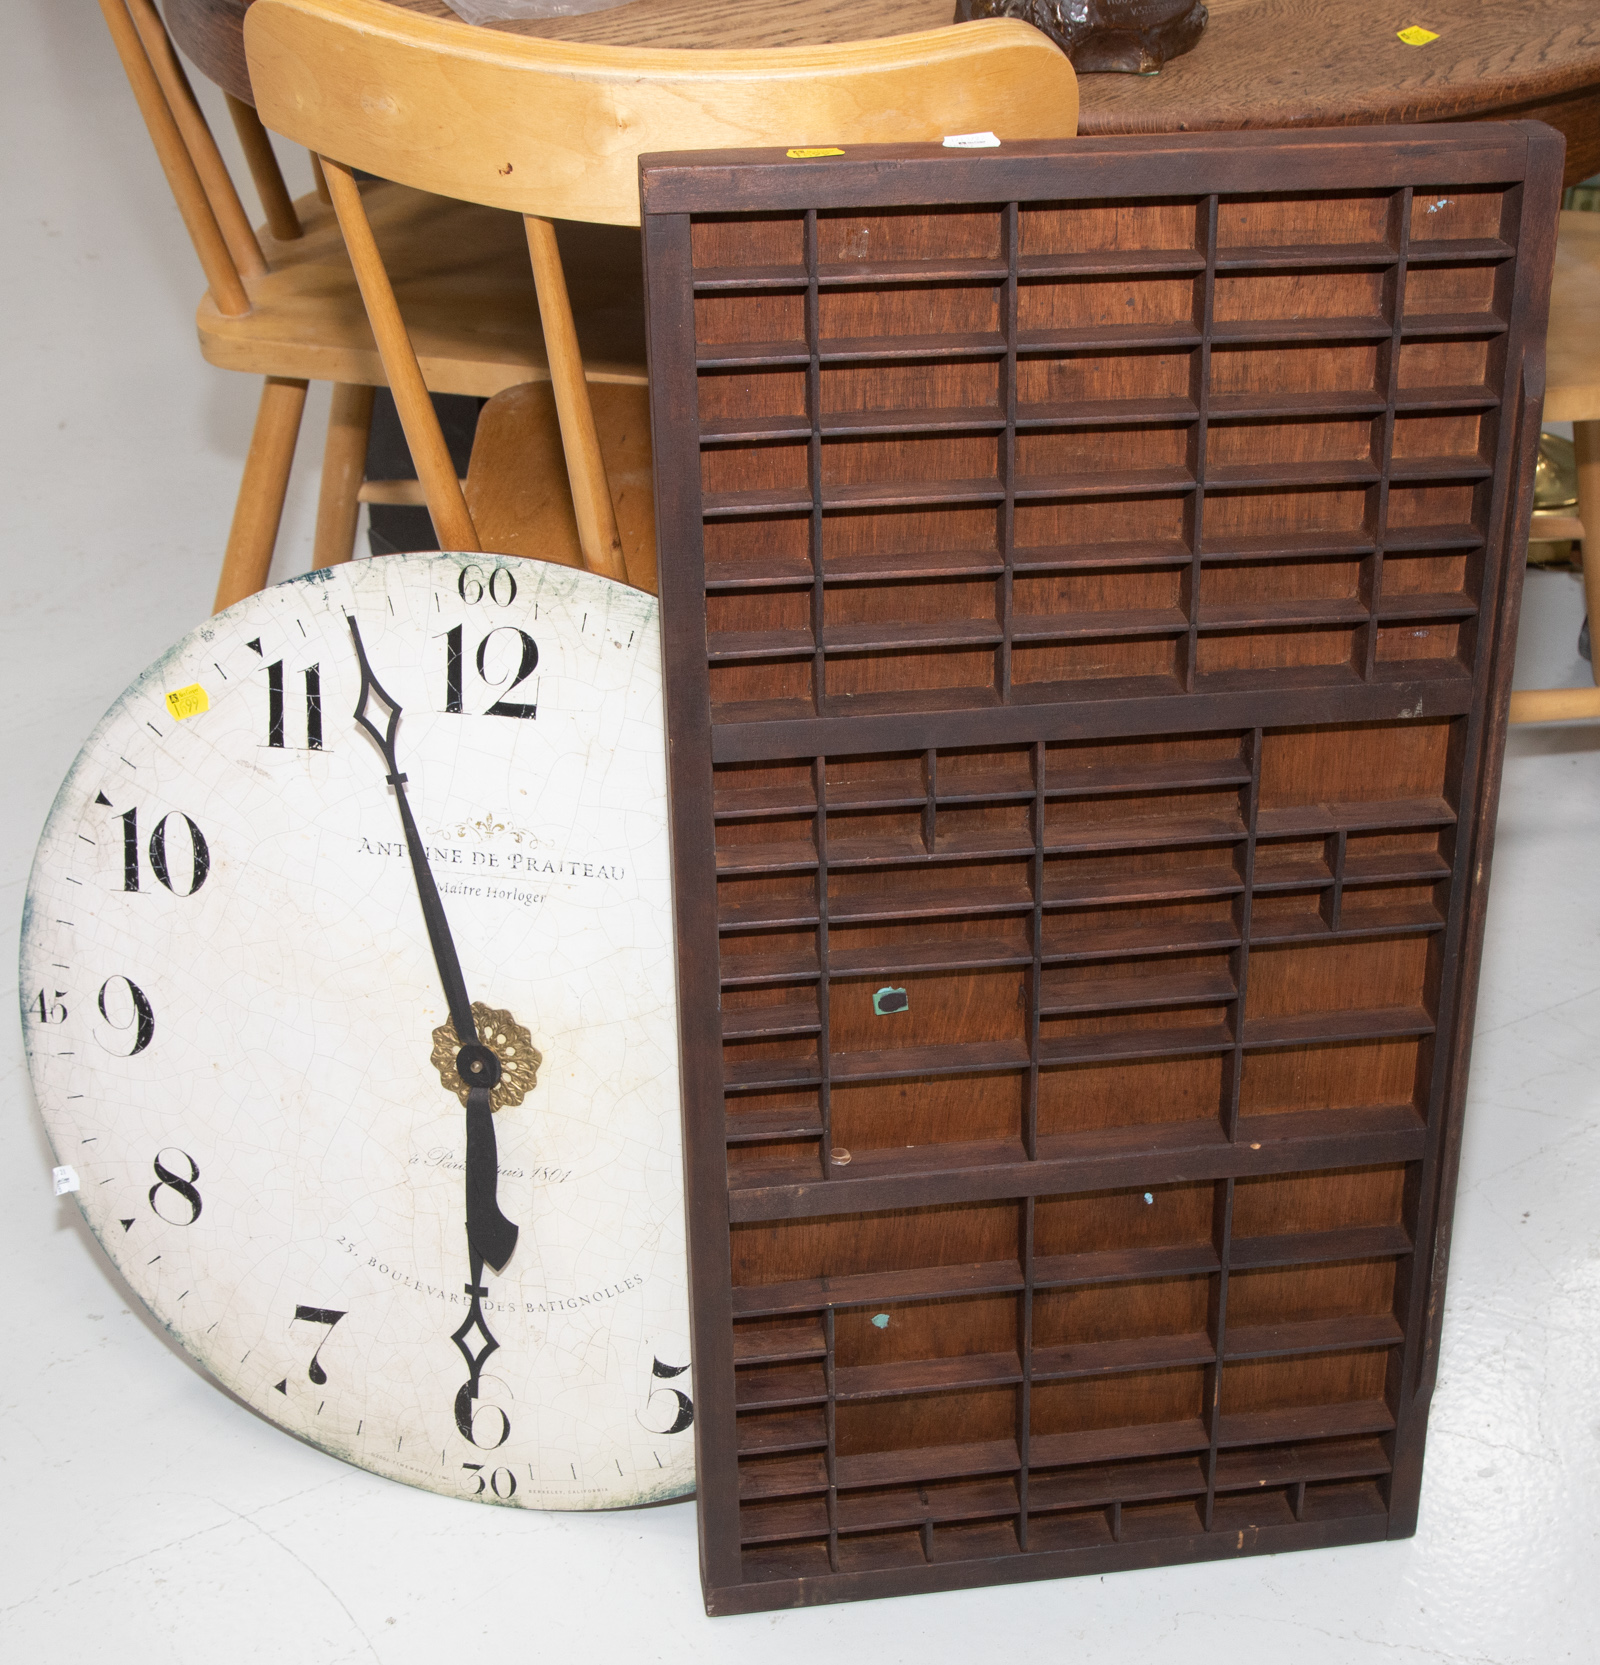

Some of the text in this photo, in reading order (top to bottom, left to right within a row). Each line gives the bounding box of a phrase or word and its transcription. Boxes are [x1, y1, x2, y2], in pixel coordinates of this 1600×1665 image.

[458, 564, 517, 607] 60
[256, 658, 334, 752] 11
[432, 623, 540, 720] 12
[110, 806, 211, 897] 10
[357, 837, 625, 881] ANTINE DE PRAITEAU
[486, 886, 547, 907] Horloger
[29, 987, 69, 1024] 45
[93, 974, 155, 1057] 9
[148, 1147, 203, 1226] 8
[336, 1235, 358, 1257] 25,
[484, 1300, 516, 1313] DES
[526, 1273, 644, 1313] BATIGNOLLES
[288, 1304, 349, 1385] 7
[454, 1374, 514, 1450] 6
[634, 1354, 694, 1434] 5
[460, 1462, 517, 1499] 30
